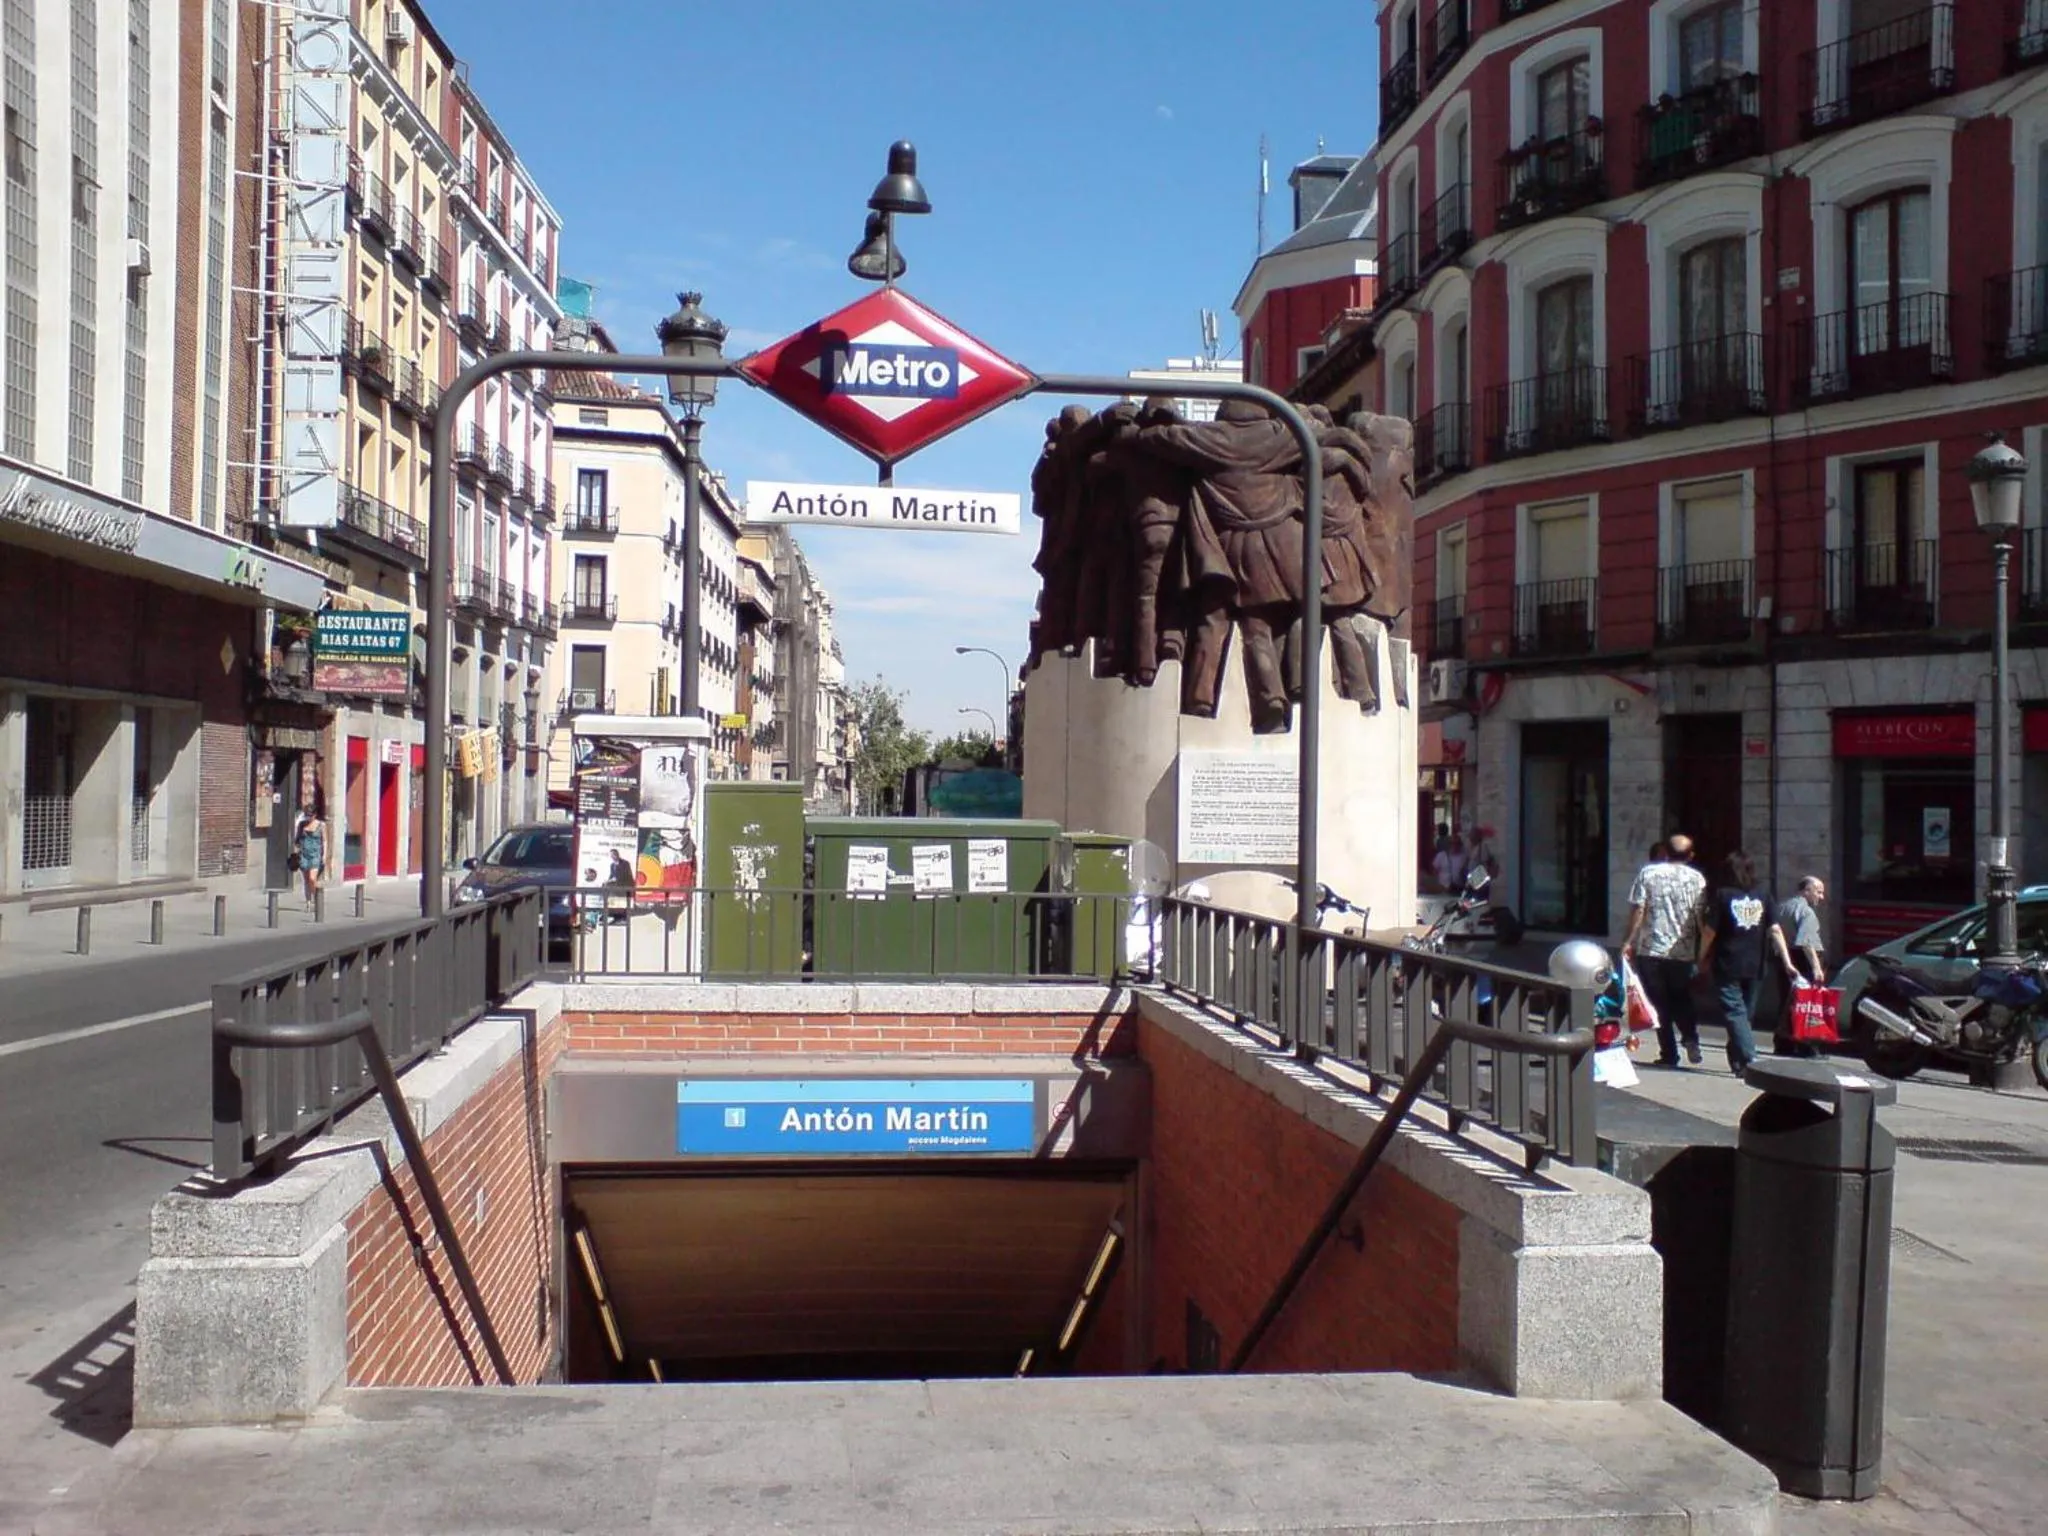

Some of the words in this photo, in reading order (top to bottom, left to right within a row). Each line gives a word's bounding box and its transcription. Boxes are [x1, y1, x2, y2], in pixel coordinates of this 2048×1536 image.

[833, 350, 951, 389] Metro
[771, 491, 868, 518] Antón
[892, 496, 997, 524] Martín
[318, 615, 407, 631] RESTAURANTE
[321, 633, 350, 646] RIAS
[351, 634, 387, 648] ALTAS
[388, 636, 401, 648] 67
[780, 1106, 873, 1132] Antón
[886, 1106, 988, 1131] Martín
[908, 1136, 939, 1145] acceso
[940, 1135, 988, 1146] Magdalena
